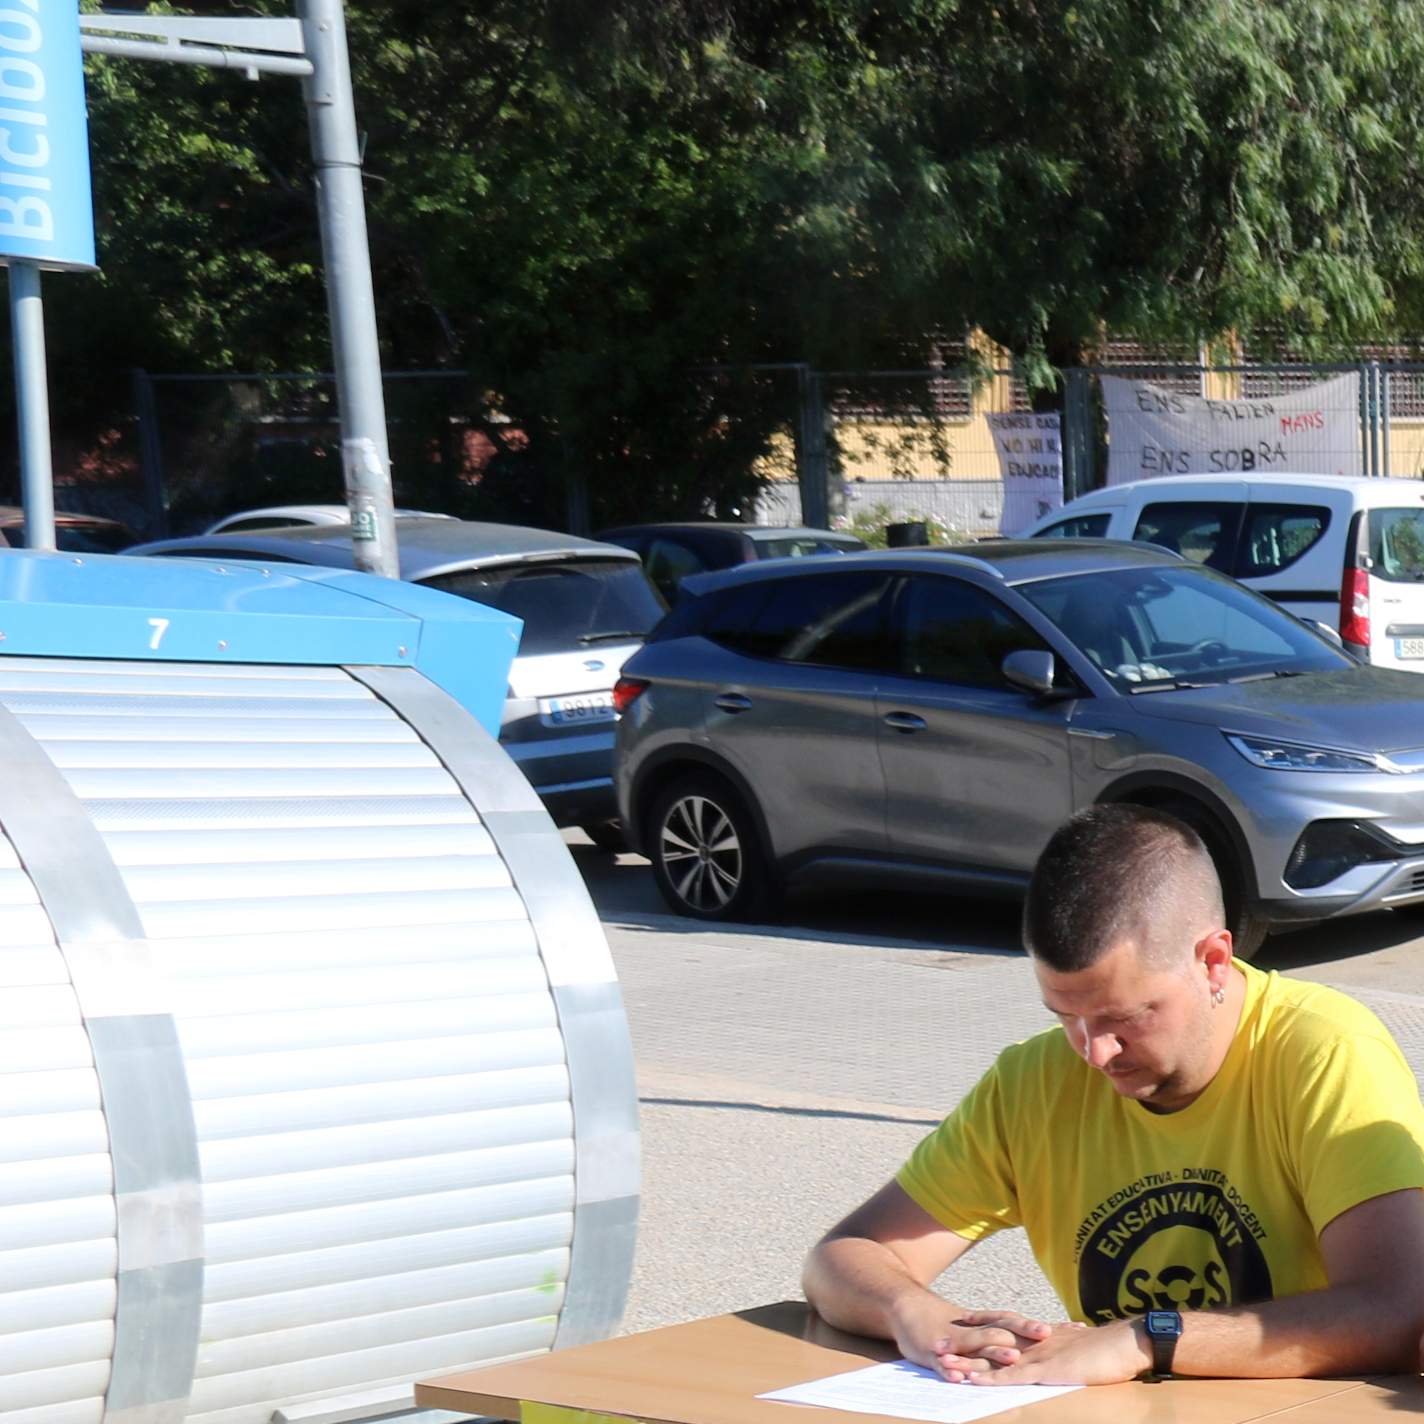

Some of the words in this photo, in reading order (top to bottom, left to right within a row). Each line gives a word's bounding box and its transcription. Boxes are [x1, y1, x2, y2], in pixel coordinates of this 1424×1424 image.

[1136, 390, 1186, 414] ENS
[1140, 446, 1190, 473] ENS
[148, 617, 170, 650] 7
[1096, 1190, 1243, 1260] ENSENYAMENT
[1226, 1185, 1268, 1241] DOCENT
